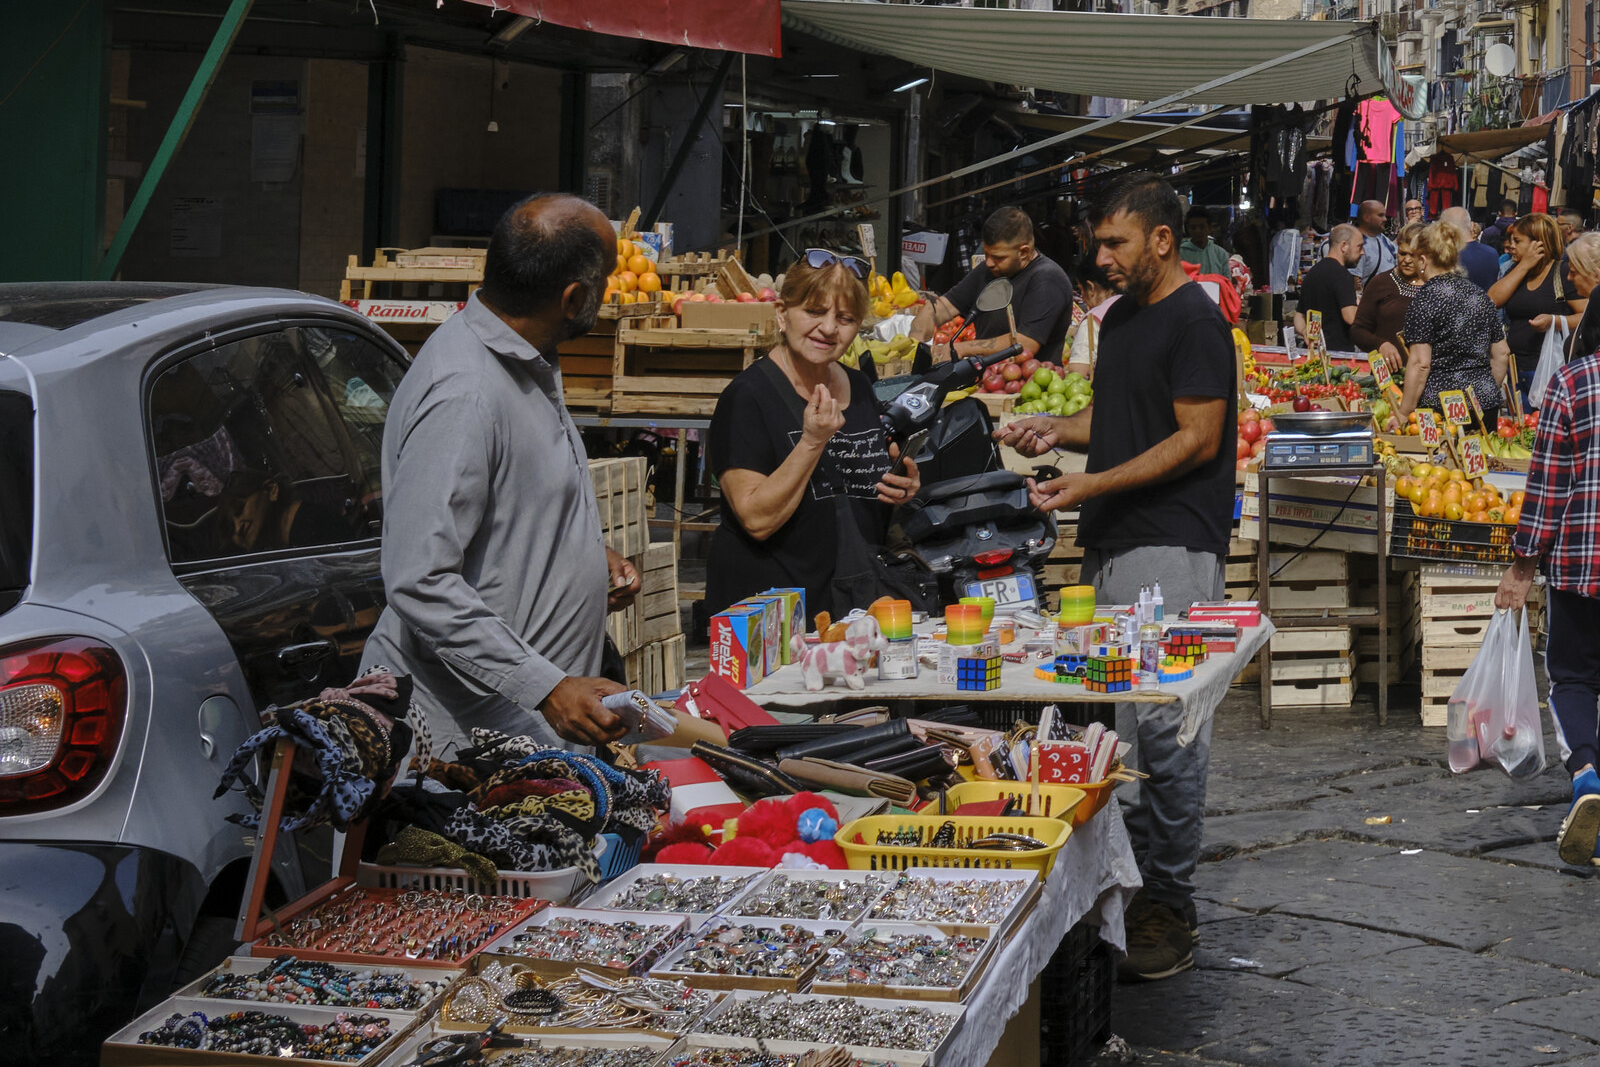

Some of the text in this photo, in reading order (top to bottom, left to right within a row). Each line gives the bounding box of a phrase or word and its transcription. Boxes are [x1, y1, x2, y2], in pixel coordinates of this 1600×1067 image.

[367, 305, 429, 318] Raniol
[1463, 441, 1471, 459] 2
[712, 641, 720, 661] stunt
[718, 622, 735, 676] TRACK
[731, 656, 740, 684] CAR
